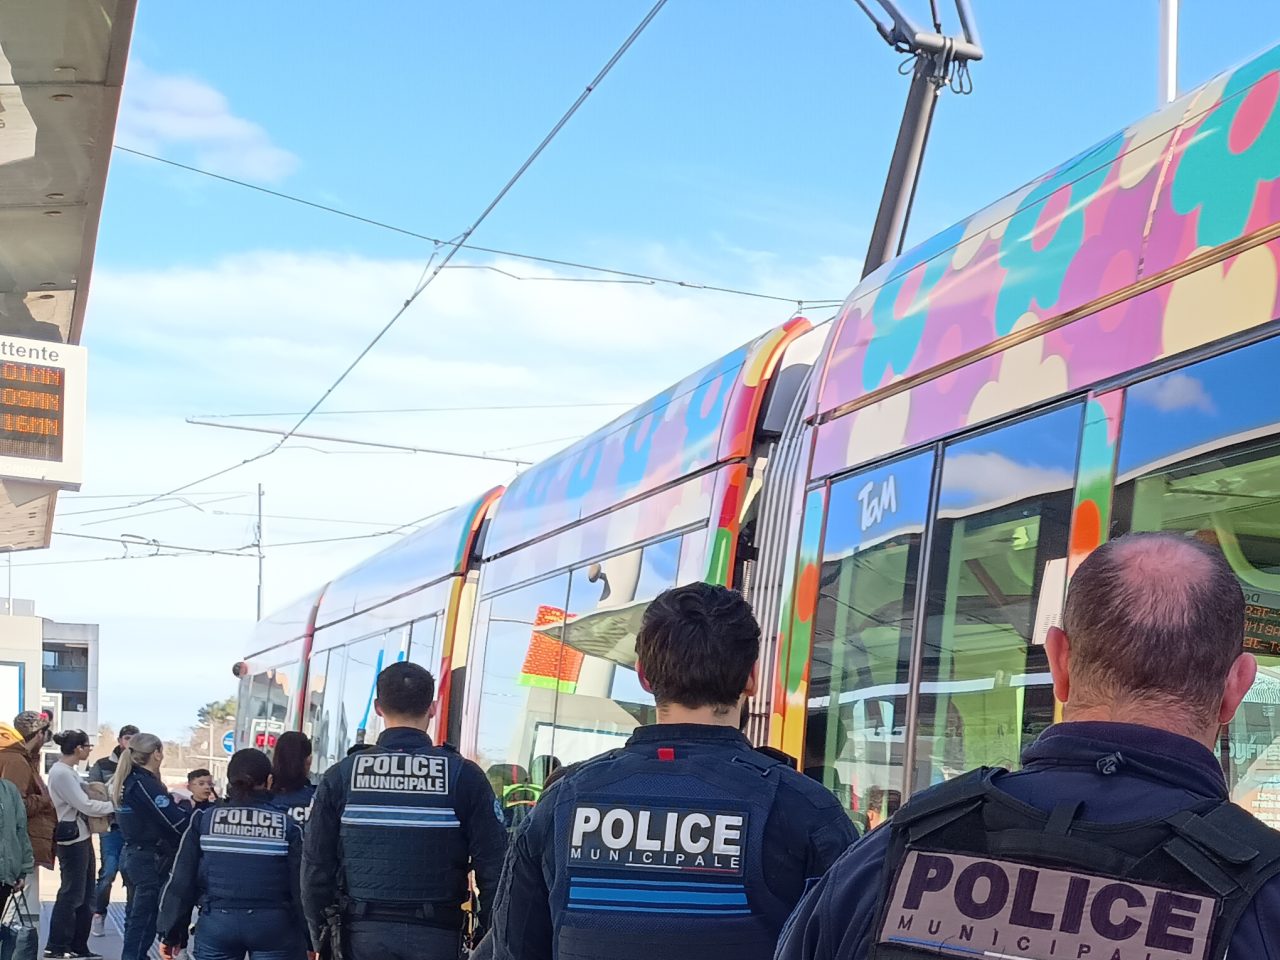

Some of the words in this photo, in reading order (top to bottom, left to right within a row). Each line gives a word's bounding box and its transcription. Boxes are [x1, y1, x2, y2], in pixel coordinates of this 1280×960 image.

[357, 755, 444, 778] POLICE
[356, 776, 444, 791] MUNICIPALE
[214, 807, 284, 828] POLICE
[213, 822, 284, 839] MUNICIPALE
[571, 807, 743, 856] POLICE
[571, 848, 741, 868] MUNICIPALE
[902, 854, 1203, 955] POLICE
